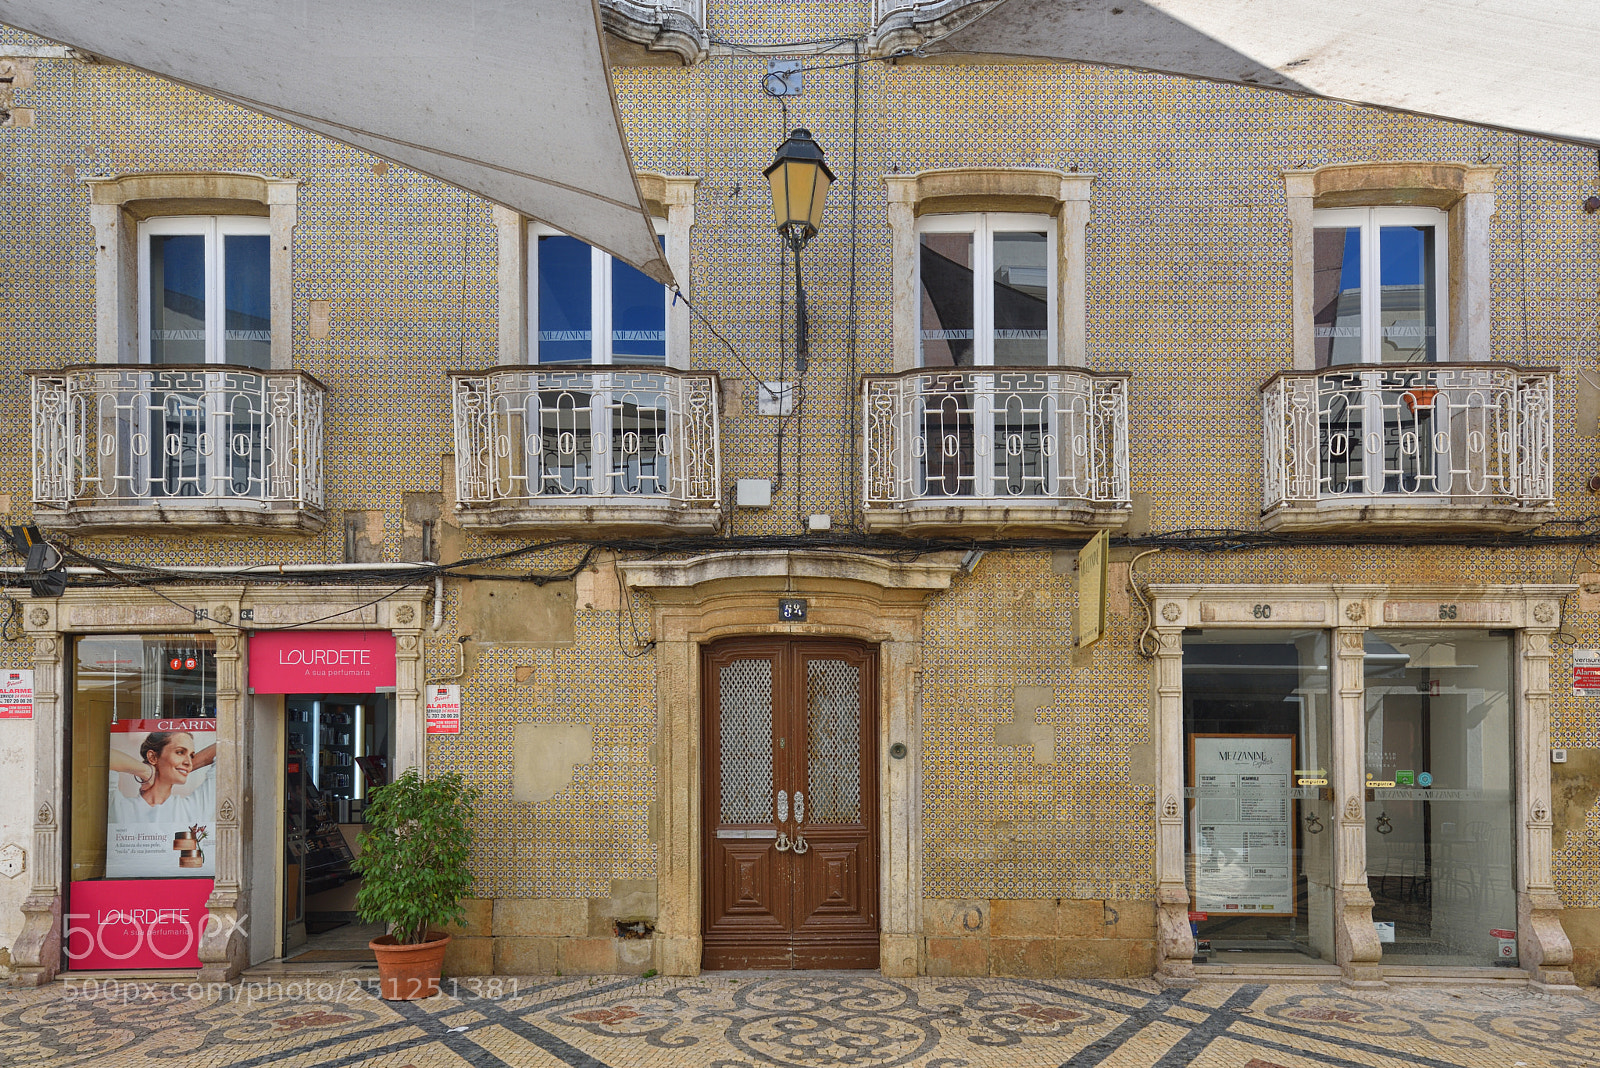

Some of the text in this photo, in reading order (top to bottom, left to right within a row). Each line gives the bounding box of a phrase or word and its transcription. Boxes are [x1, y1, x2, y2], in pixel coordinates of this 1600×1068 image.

[616, 330, 663, 341] MEZZANINE
[996, 329, 1045, 340] MEZZANINE
[1253, 604, 1271, 619] 60
[1438, 604, 1457, 620] 58
[279, 649, 371, 665] LOURDETE
[328, 668, 371, 678] perfumaria
[1219, 751, 1267, 761] MEZZANINE
[115, 832, 168, 842] Extra-Firming
[97, 908, 190, 925] LOURDETE
